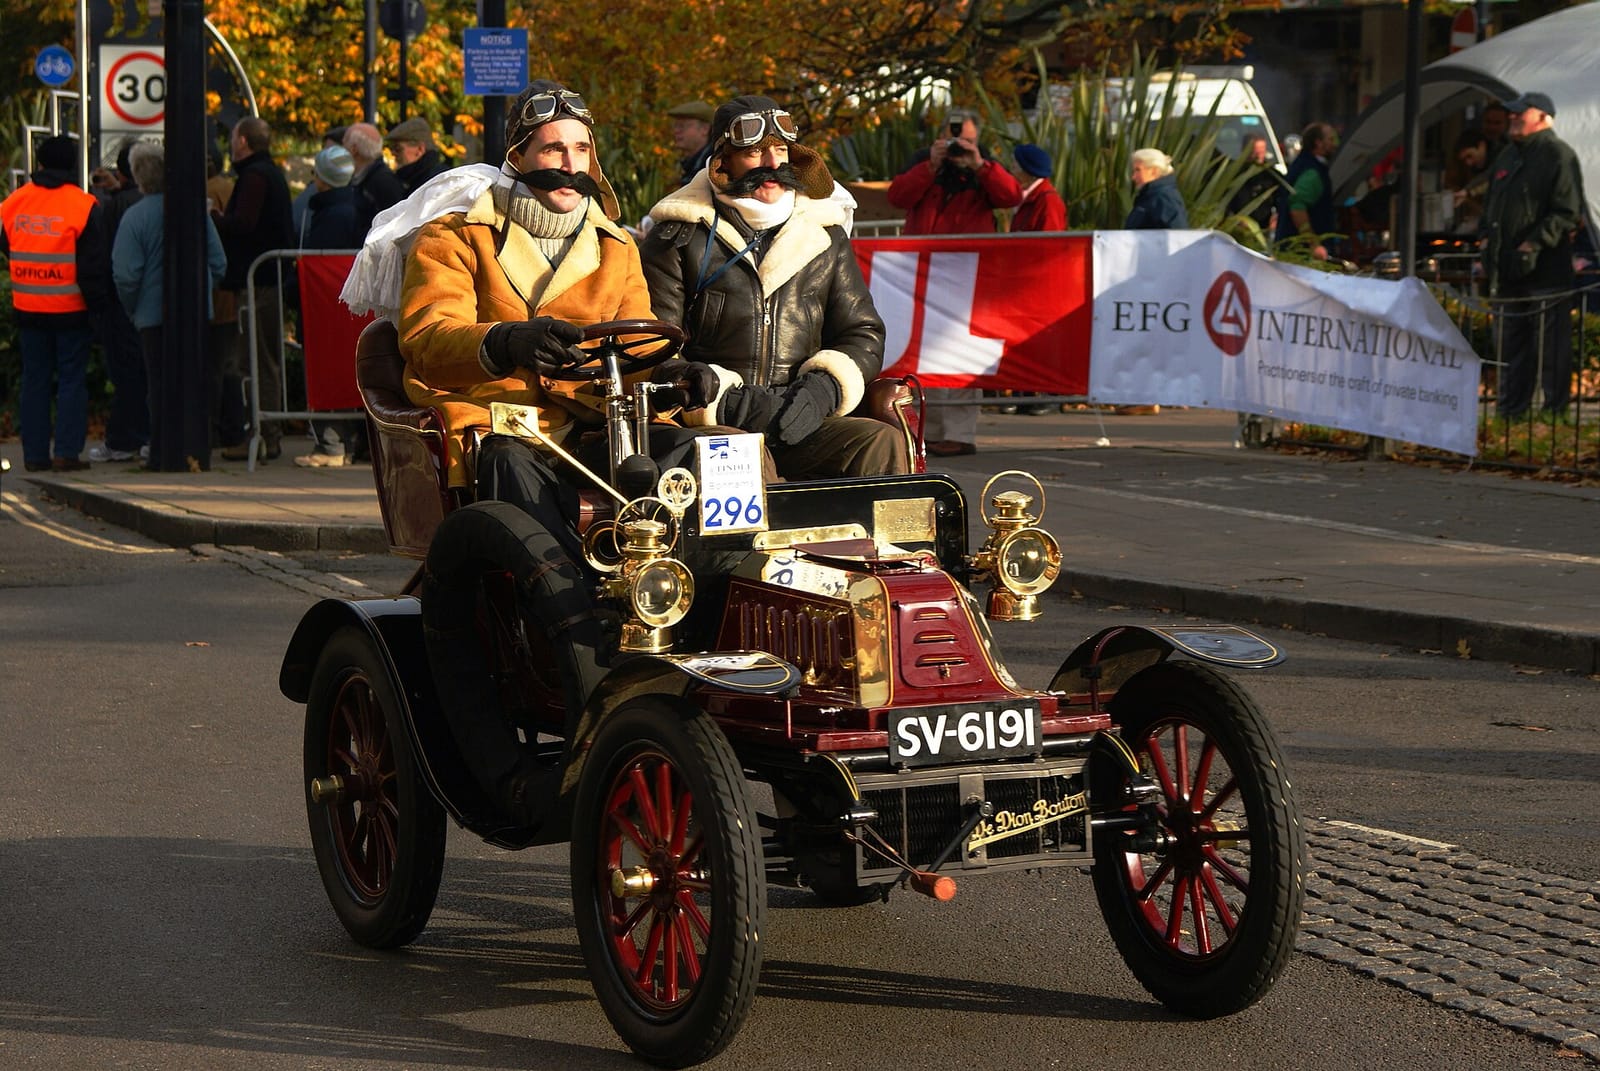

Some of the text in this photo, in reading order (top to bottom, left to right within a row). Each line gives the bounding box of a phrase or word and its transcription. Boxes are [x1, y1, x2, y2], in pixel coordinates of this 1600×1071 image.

[480, 35, 512, 46] NOTICE
[118, 74, 167, 103] 30
[15, 267, 64, 280] OFFICIAL
[1112, 301, 1463, 370] EFG INTERNATIONAL
[1329, 372, 1345, 389] the
[1383, 383, 1417, 401] private
[1418, 386, 1459, 411] banking
[704, 495, 762, 528] 296
[897, 708, 1036, 758] SV-6191
[995, 810, 1034, 833] Dion
[1033, 790, 1087, 821] Bouton
